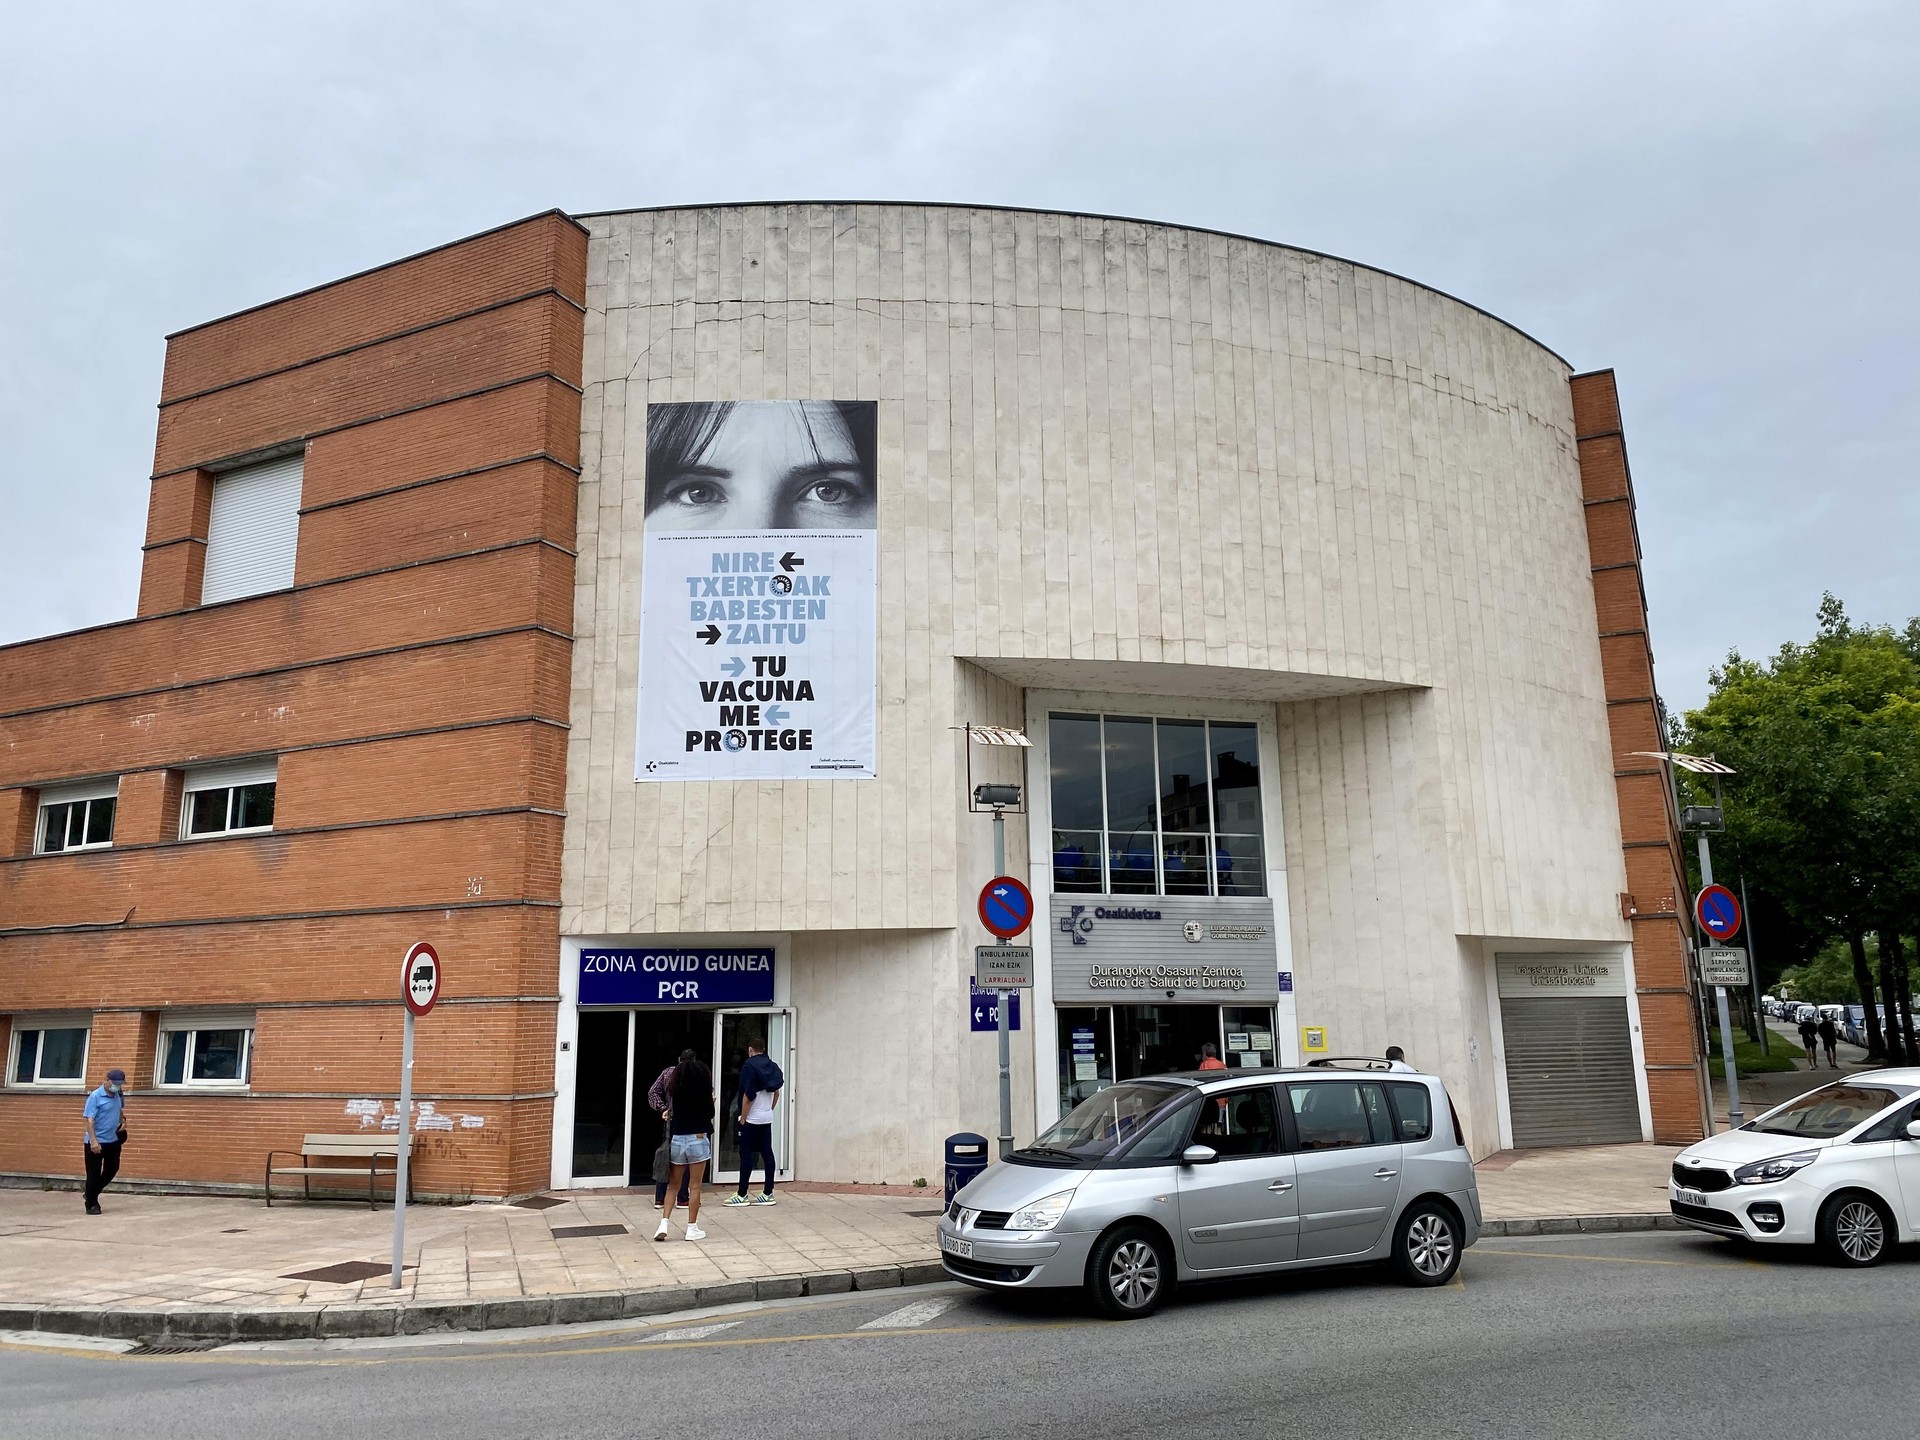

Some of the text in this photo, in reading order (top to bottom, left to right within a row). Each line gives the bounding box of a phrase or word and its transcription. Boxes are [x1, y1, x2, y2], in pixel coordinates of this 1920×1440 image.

[711, 552, 775, 573] NIRE
[690, 599, 826, 622] BABESTEN
[726, 623, 806, 645] ZAITU
[751, 656, 787, 677] TU
[699, 680, 815, 702] VACUNA
[719, 705, 760, 726] ME
[685, 729, 813, 753] PROTEGE
[1094, 906, 1162, 920] Osakidetza
[584, 955, 770, 973] ZONA COVID GUNEA
[1092, 964, 1243, 978] Durangoko Osasun Zentroa
[658, 981, 699, 999] PCR
[1089, 977, 1247, 990] Centro de Salud de Durango
[1531, 975, 1596, 986] Unidad Docente
